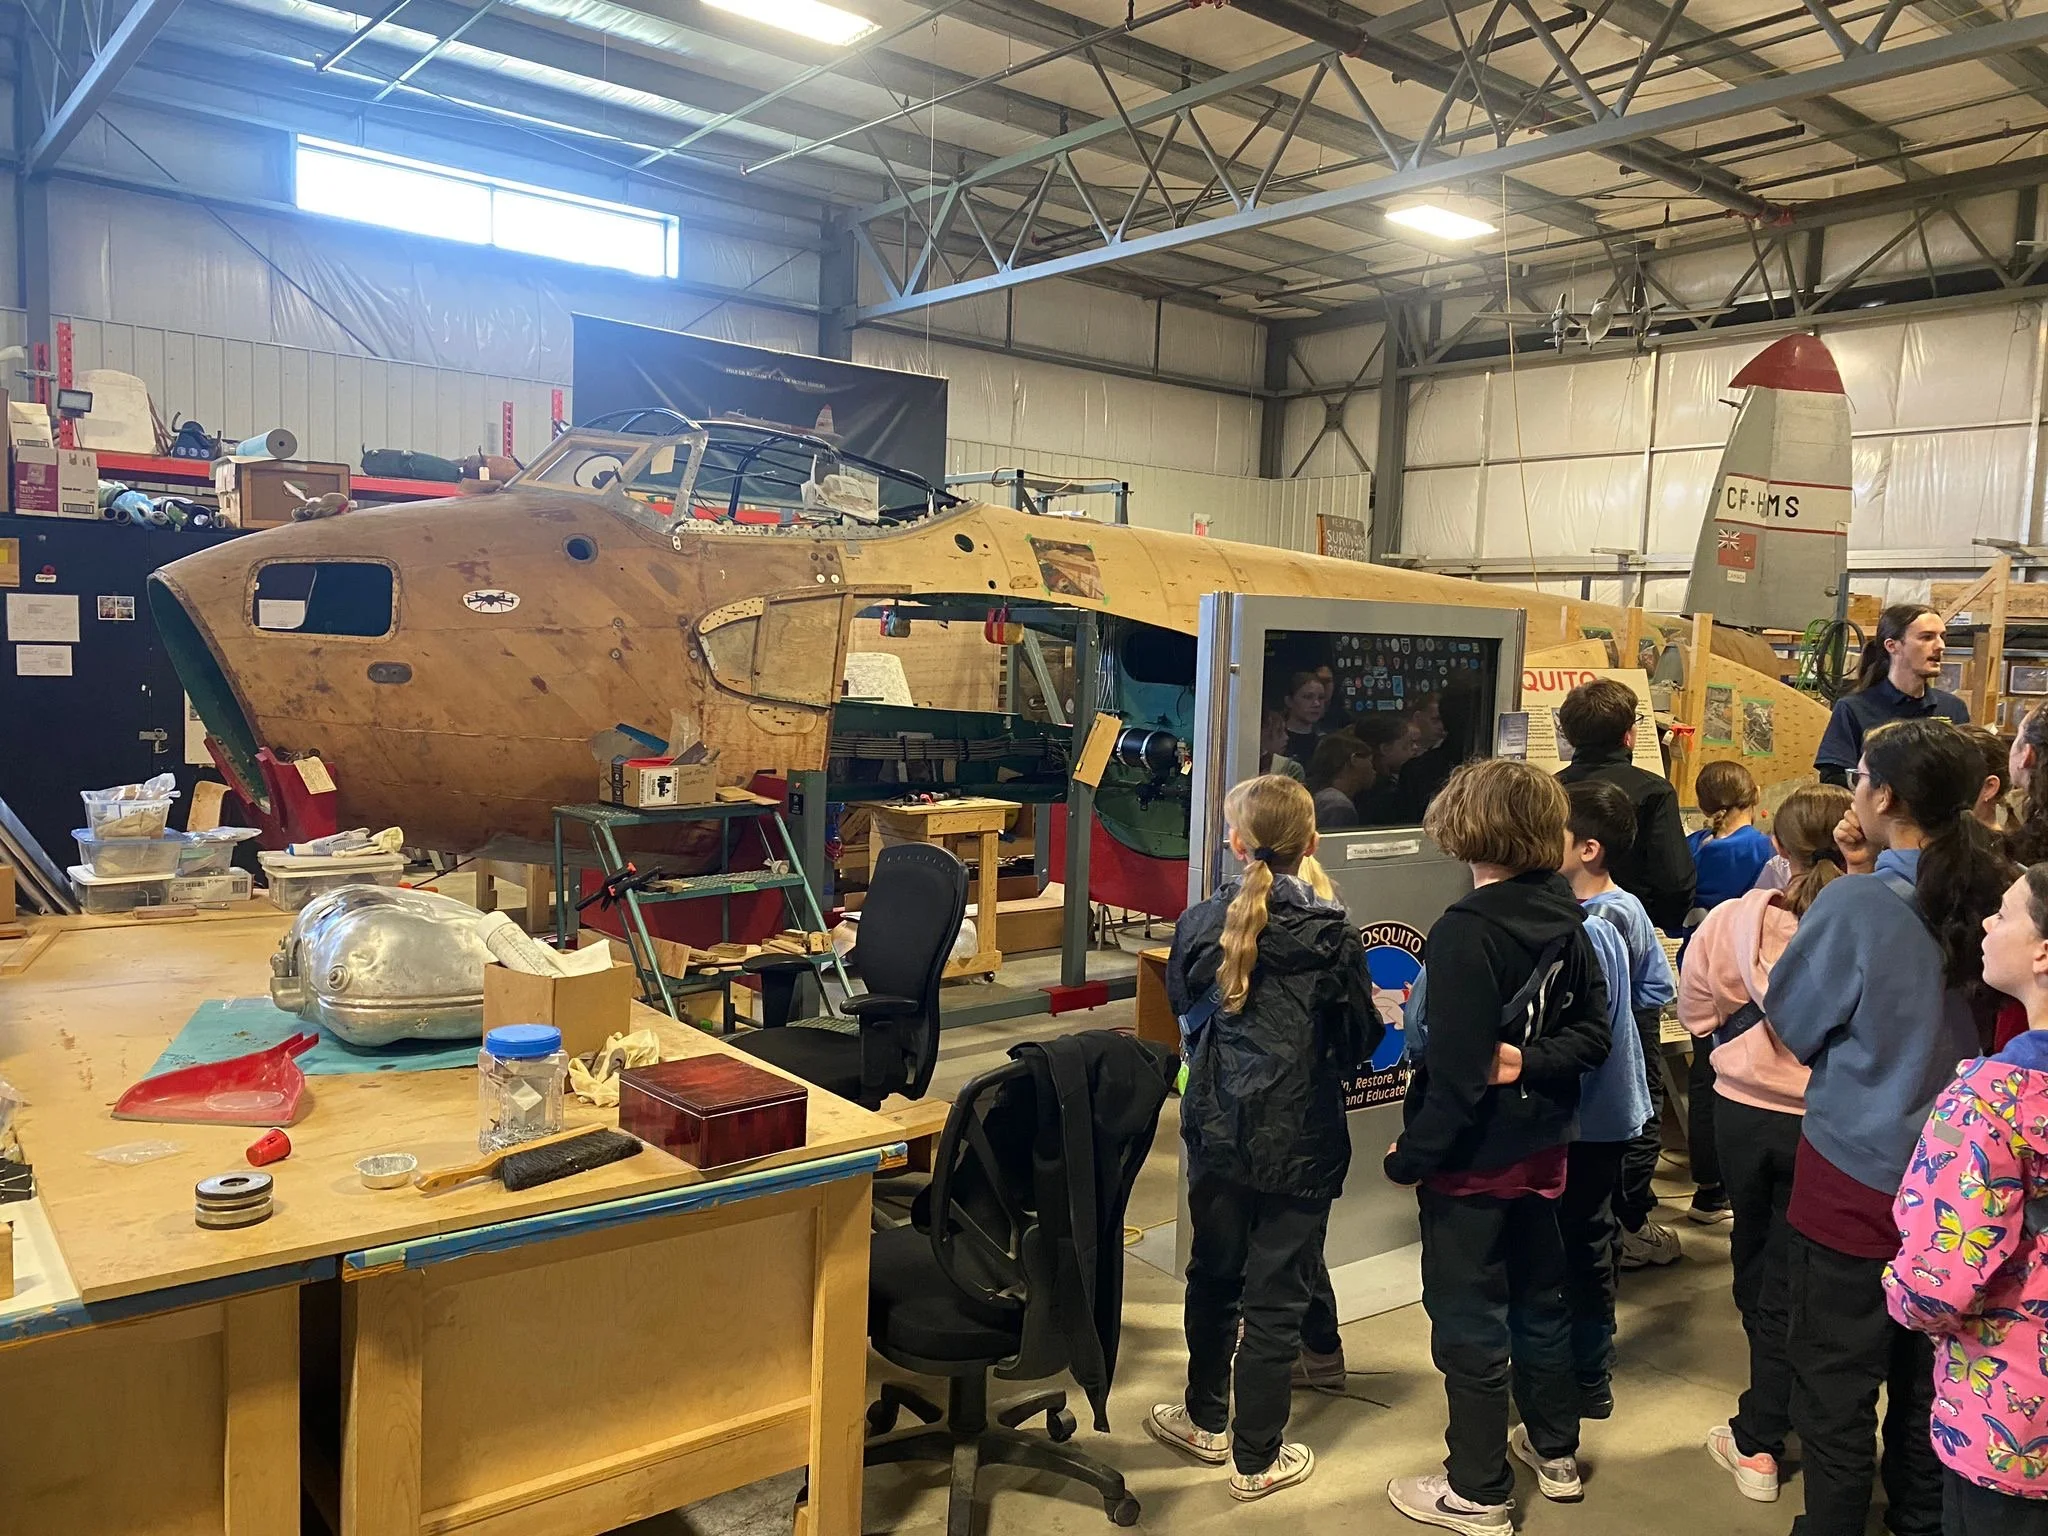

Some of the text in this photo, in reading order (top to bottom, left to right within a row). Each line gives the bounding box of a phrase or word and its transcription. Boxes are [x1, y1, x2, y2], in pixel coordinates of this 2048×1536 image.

[1727, 486, 1800, 518] CF-HMS
[1522, 670, 1598, 692] QUITO
[1361, 926, 1422, 953] OSQUITO
[1355, 1072, 1395, 1090] Restore,
[1345, 1091, 1364, 1107] and
[1366, 1085, 1405, 1104] Educate
